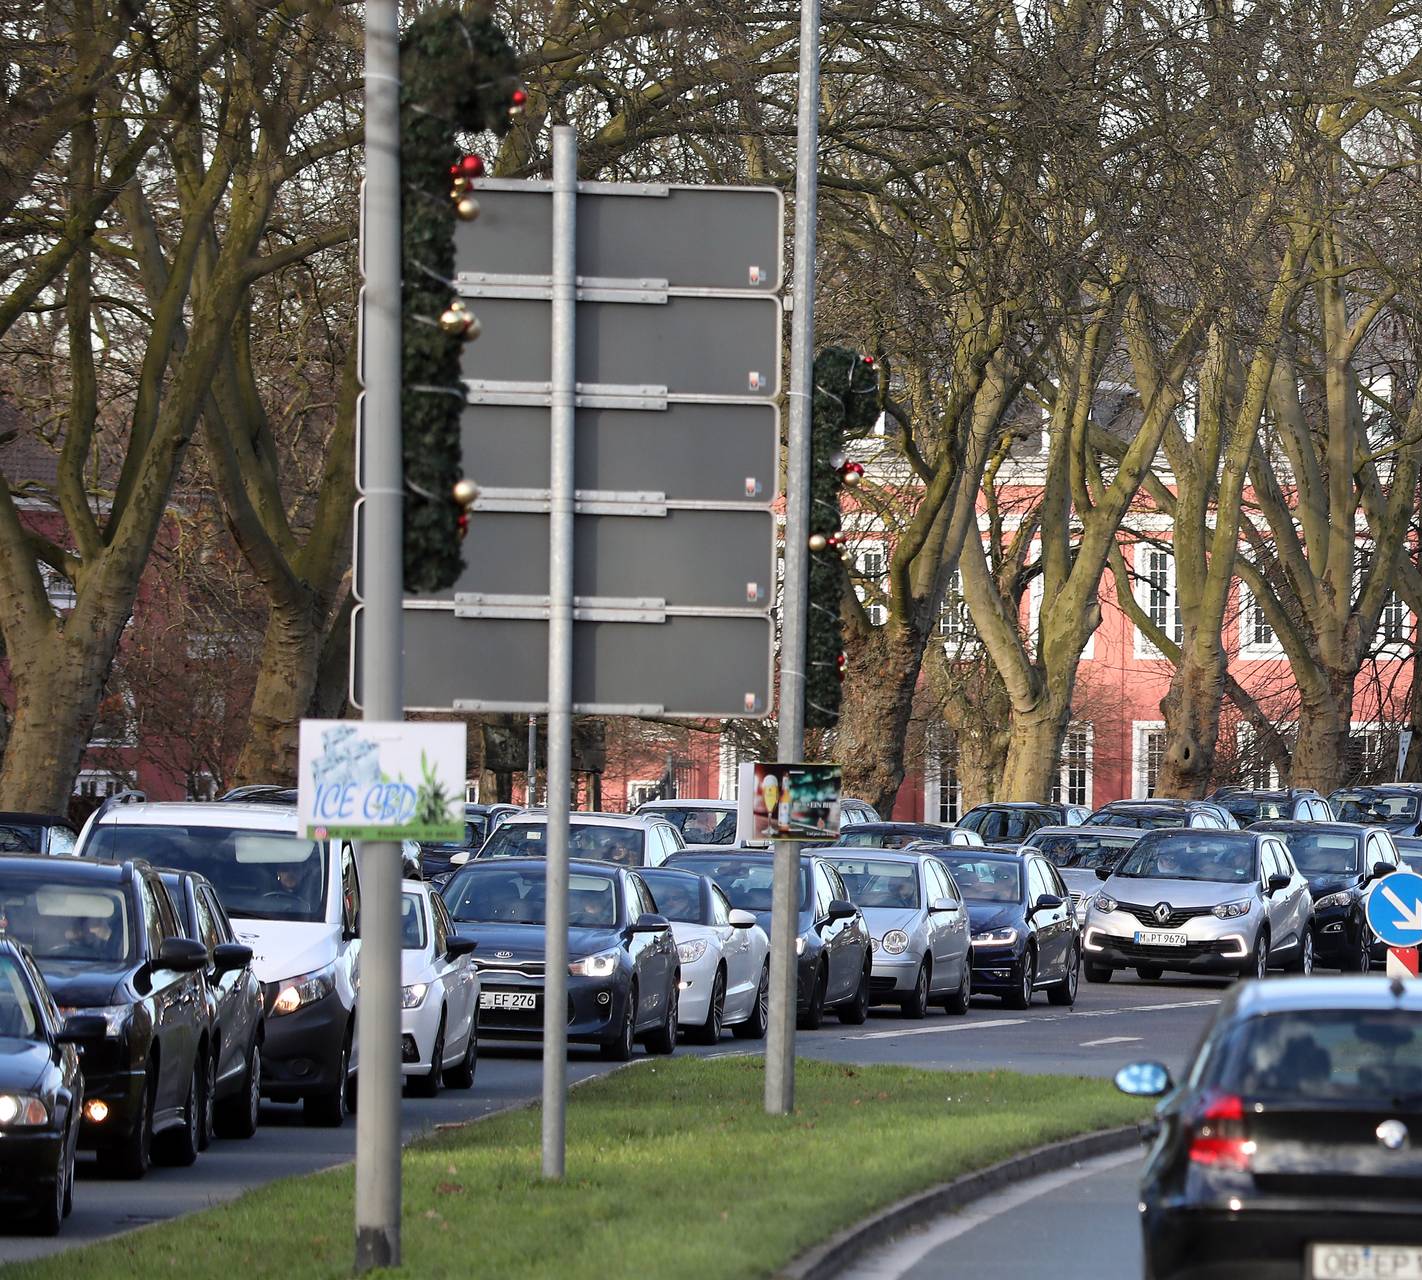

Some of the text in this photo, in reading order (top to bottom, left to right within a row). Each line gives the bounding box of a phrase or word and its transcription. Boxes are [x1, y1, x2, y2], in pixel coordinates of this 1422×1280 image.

[313, 783, 358, 820] ICE
[1150, 933, 1162, 943] PT
[1163, 934, 1186, 944] 9676
[494, 994, 510, 1006] EF
[511, 994, 535, 1007] 276
[1324, 1253, 1359, 1278] OB
